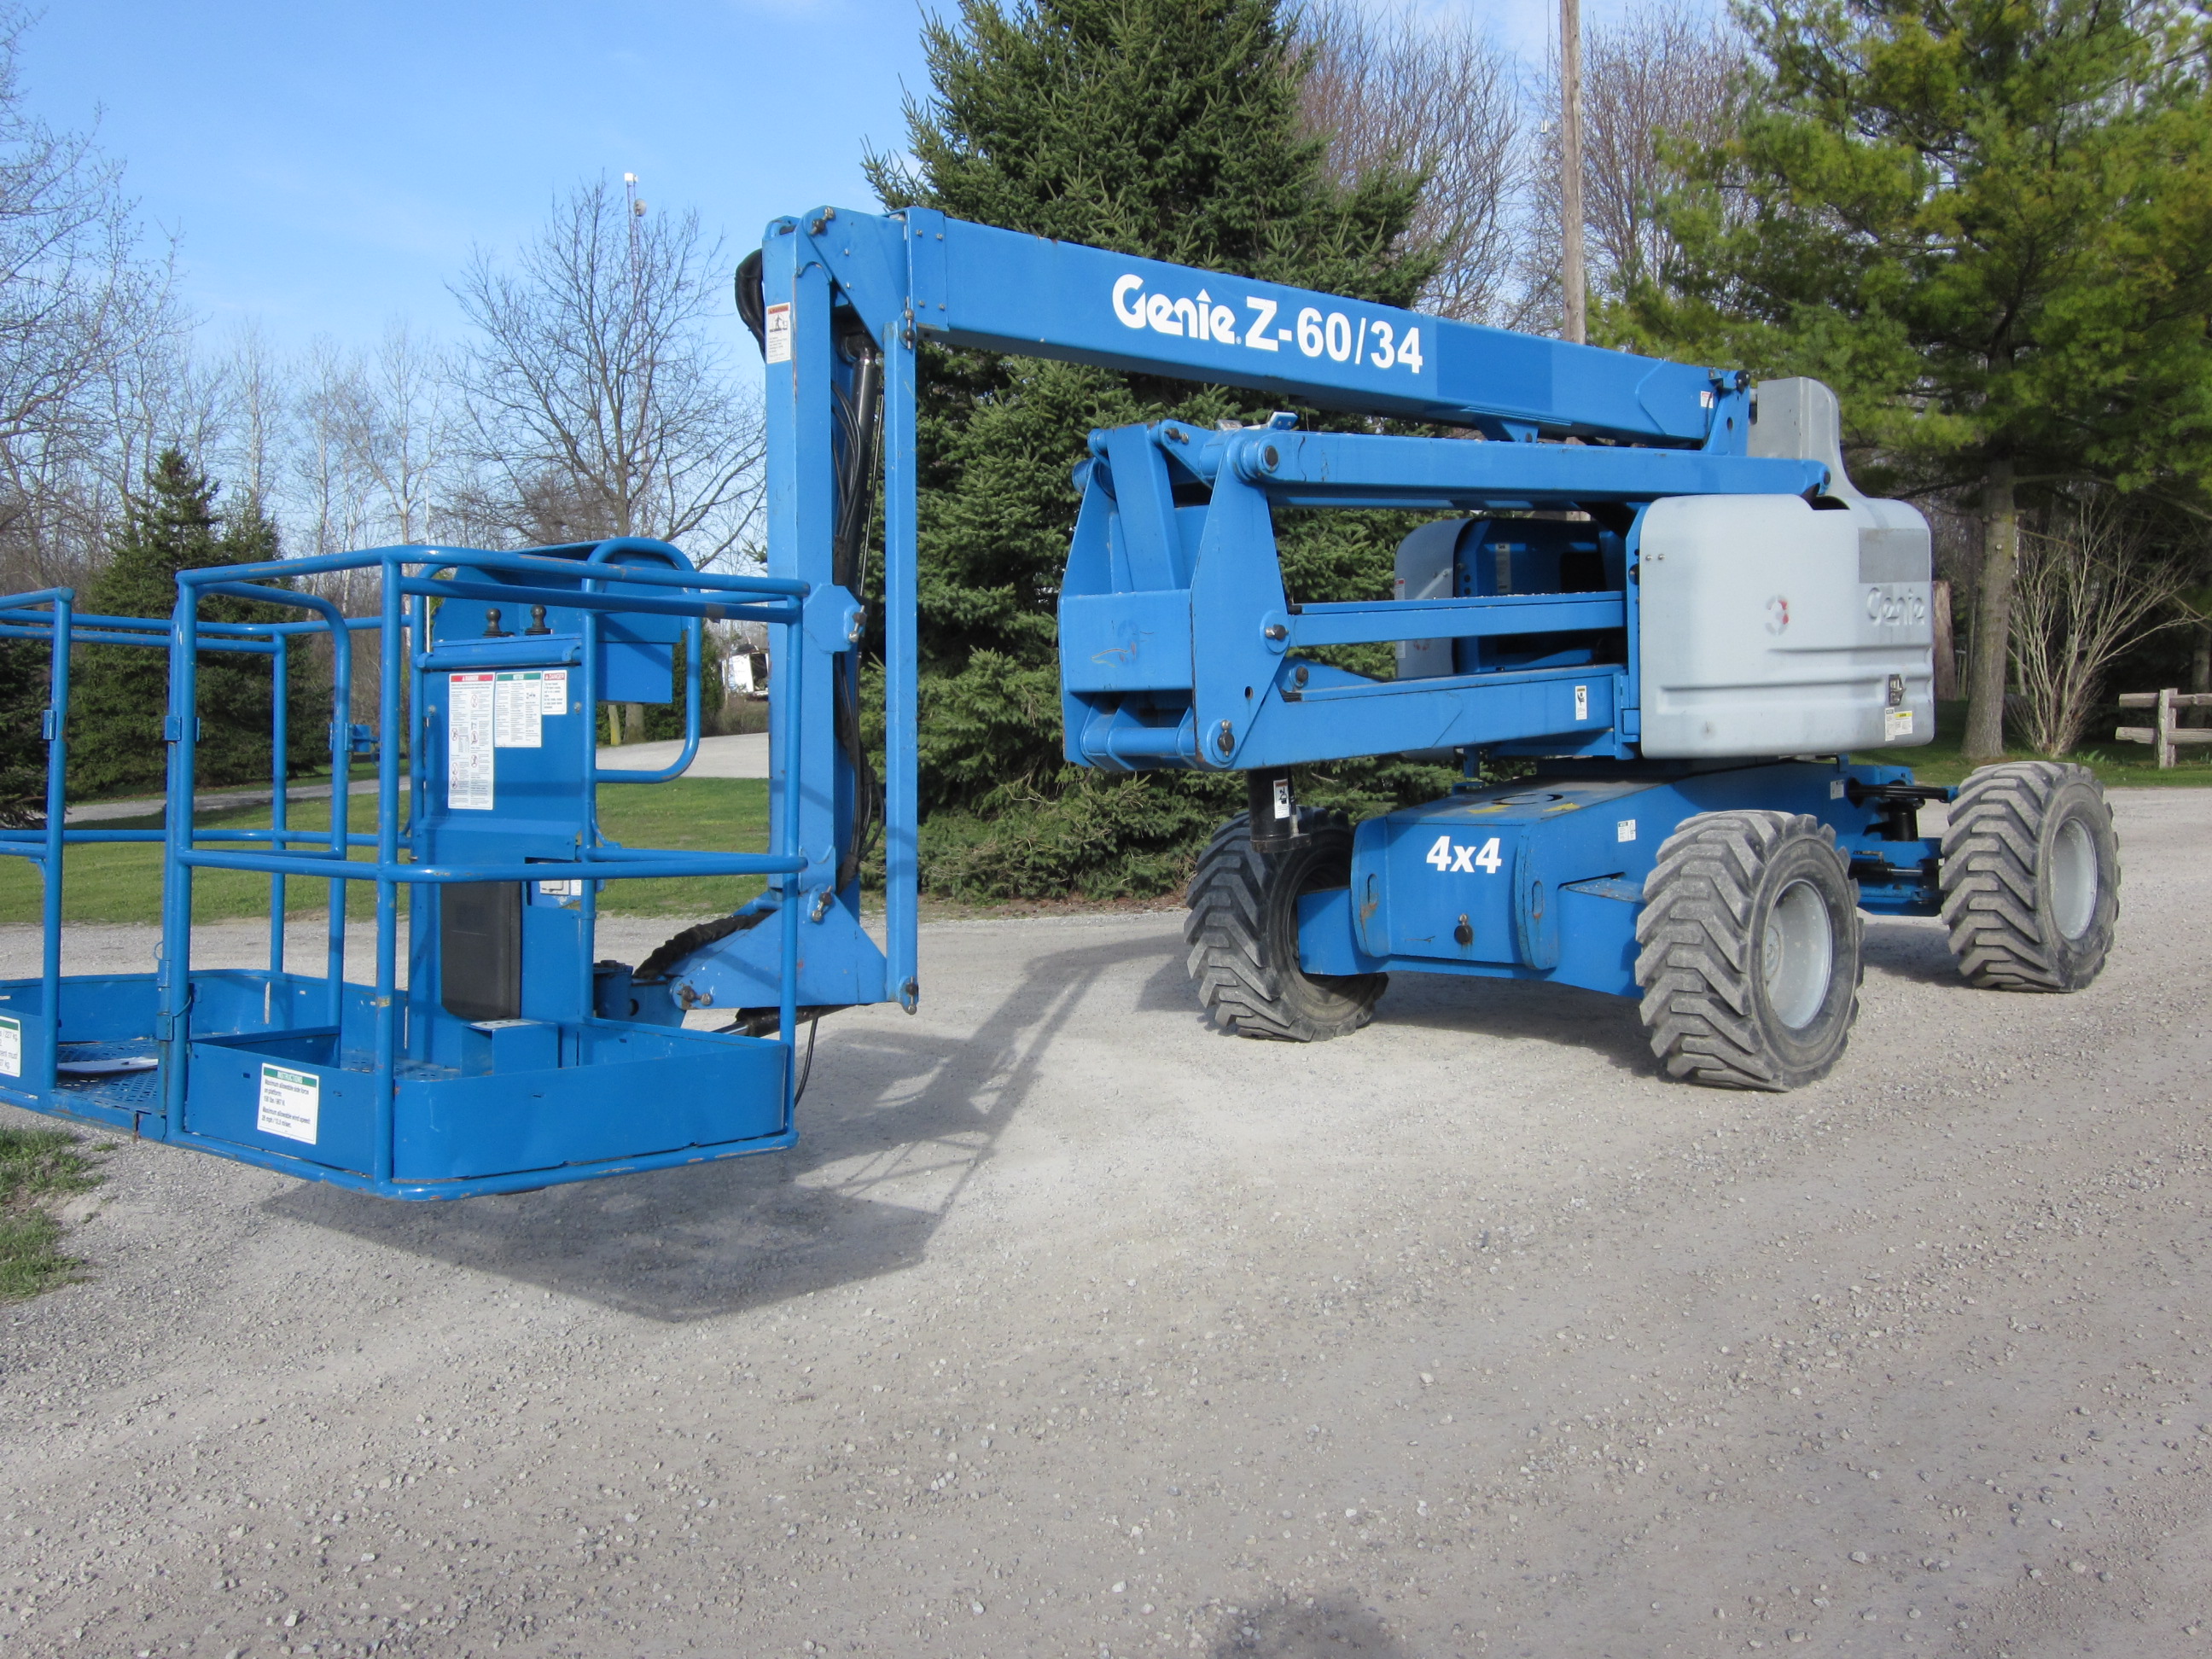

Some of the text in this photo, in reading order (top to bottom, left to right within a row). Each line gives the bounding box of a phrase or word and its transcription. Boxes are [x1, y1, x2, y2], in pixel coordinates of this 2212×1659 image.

[1245, 295, 1423, 374] Z-60/34
[1866, 586, 1925, 626] Genie
[1426, 835, 1502, 874] 4x4
